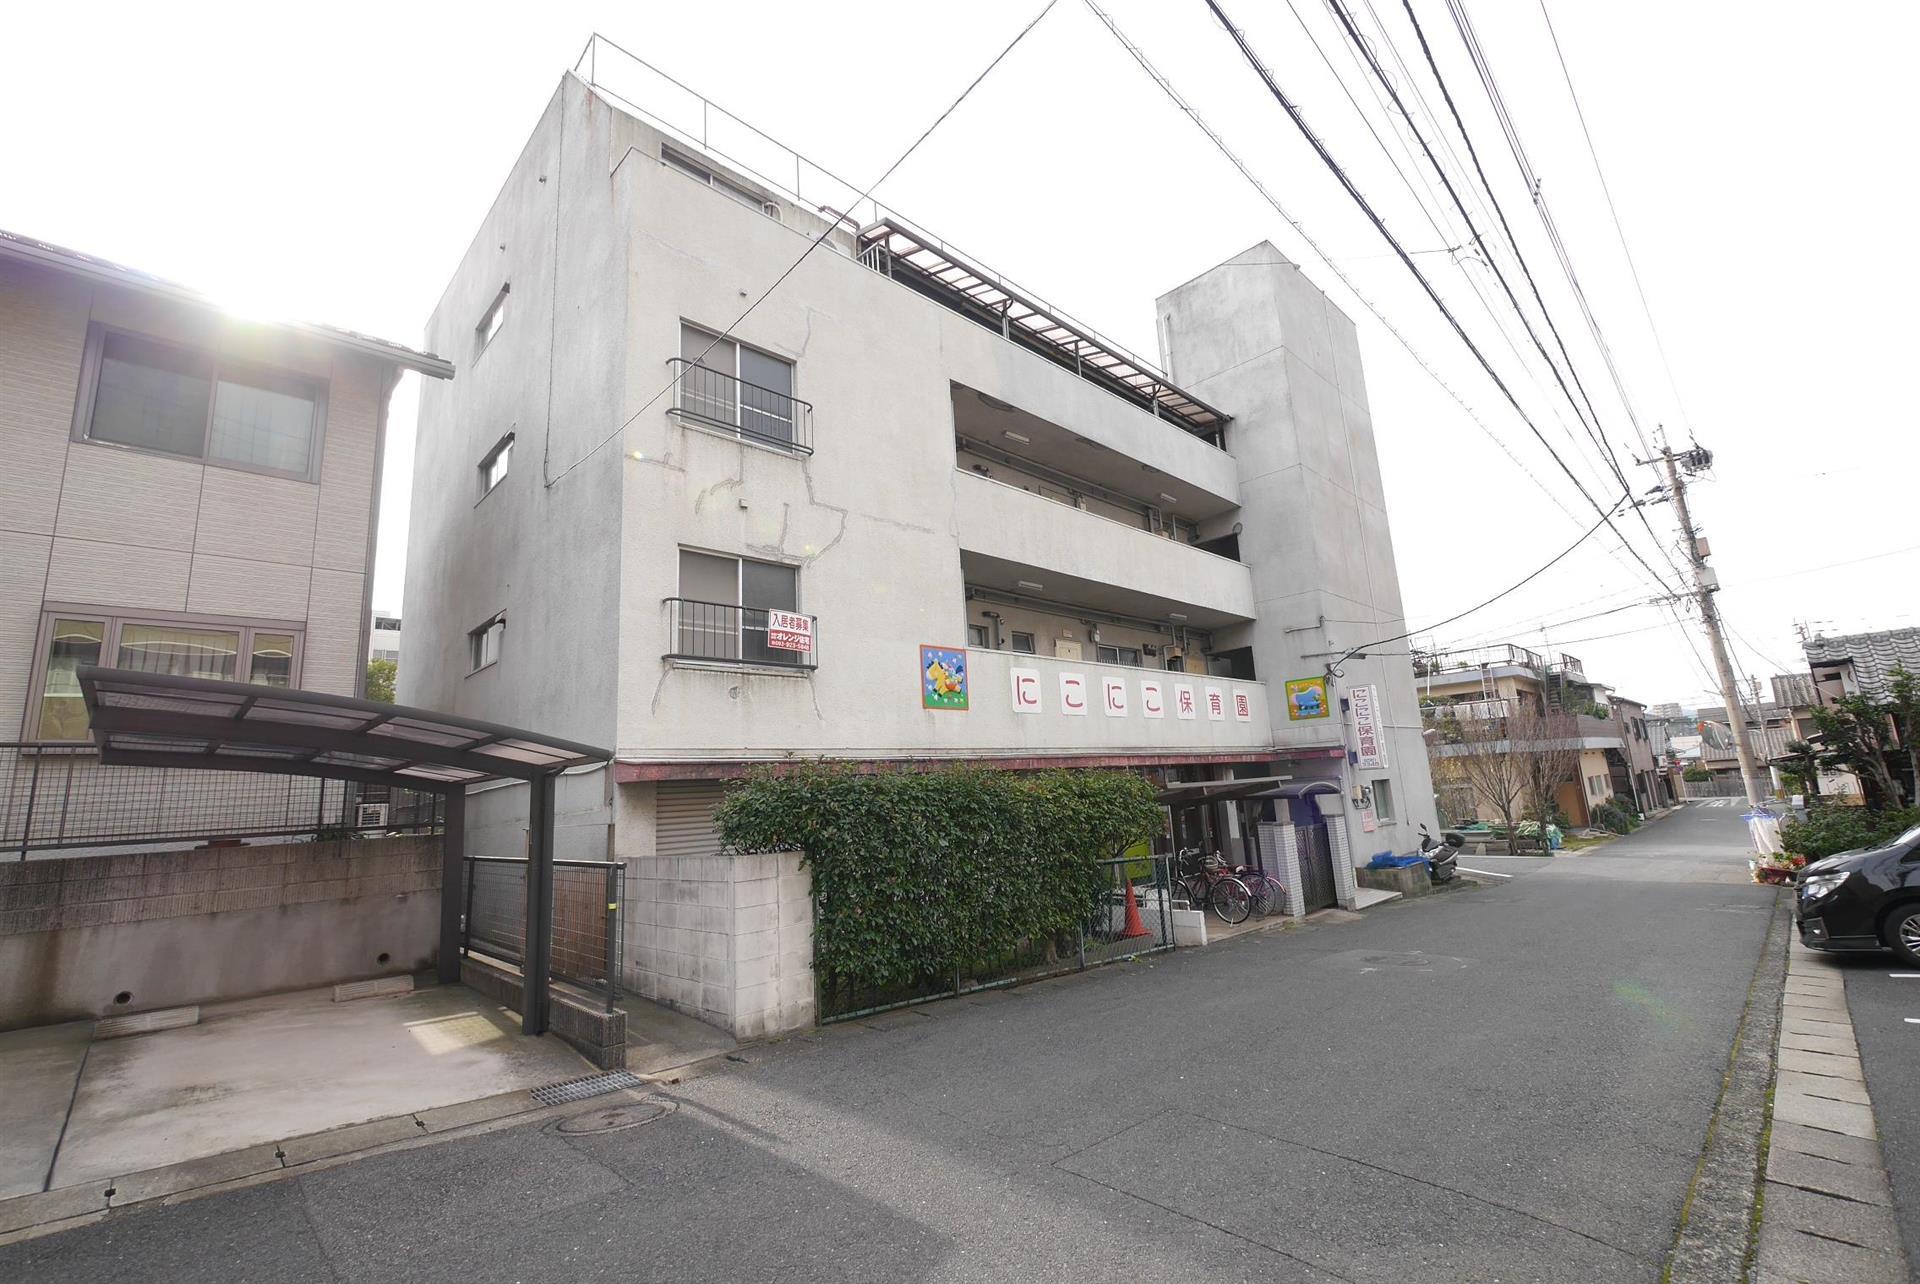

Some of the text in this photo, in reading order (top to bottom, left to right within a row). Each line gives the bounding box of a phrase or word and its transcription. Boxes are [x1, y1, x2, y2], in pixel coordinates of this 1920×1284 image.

[772, 613, 809, 631] 入居者募集
[1016, 675, 1249, 717] にこにこ保育園
[1352, 688, 1377, 757] にこにこ保育園
